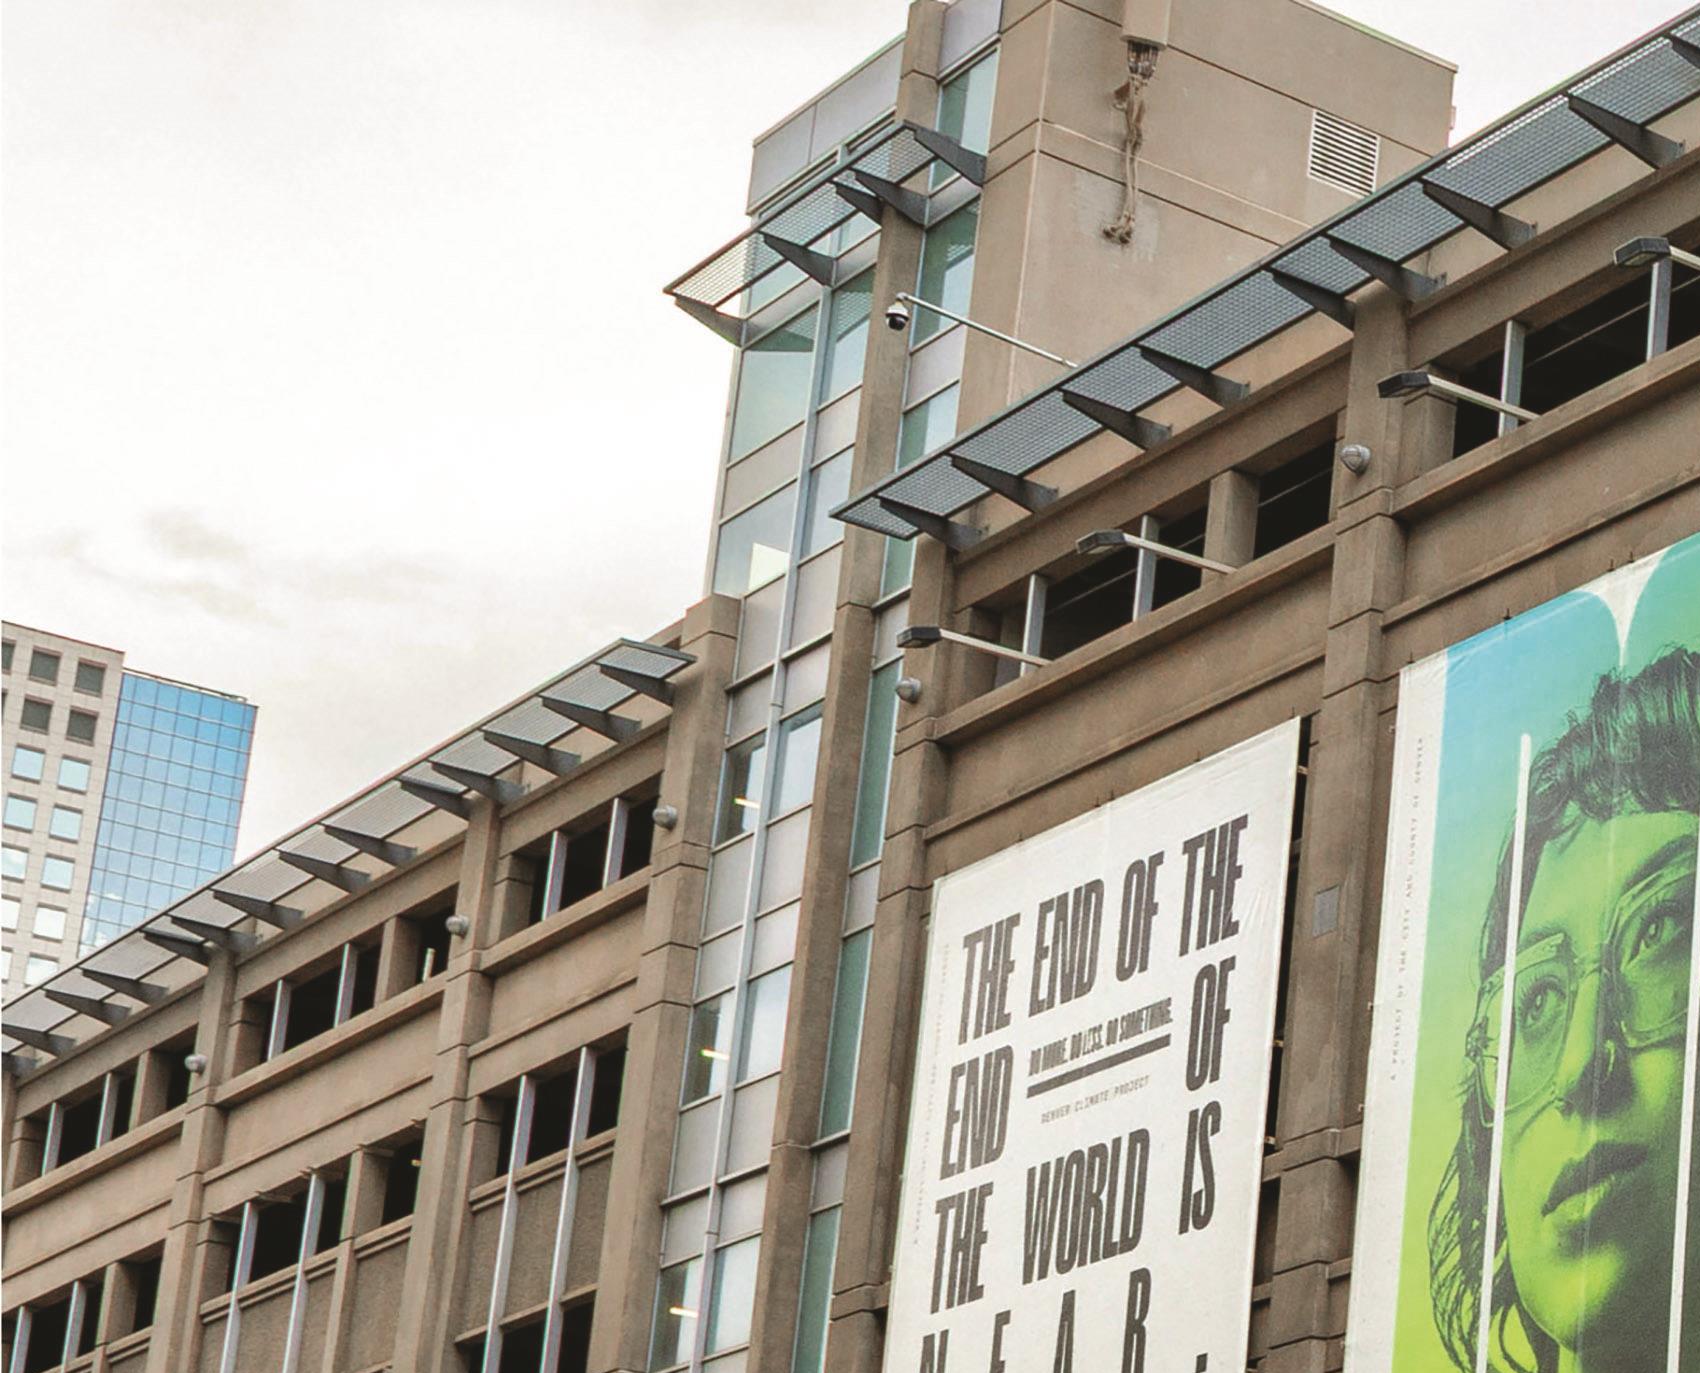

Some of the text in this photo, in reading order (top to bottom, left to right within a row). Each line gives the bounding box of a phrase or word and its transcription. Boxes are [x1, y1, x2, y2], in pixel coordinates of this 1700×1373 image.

[959, 814, 1248, 1045] THE END OF THE
[941, 1045, 1013, 1180] END
[1185, 955, 1236, 1092] OF
[931, 1100, 1222, 1315] THE WORLD IS
